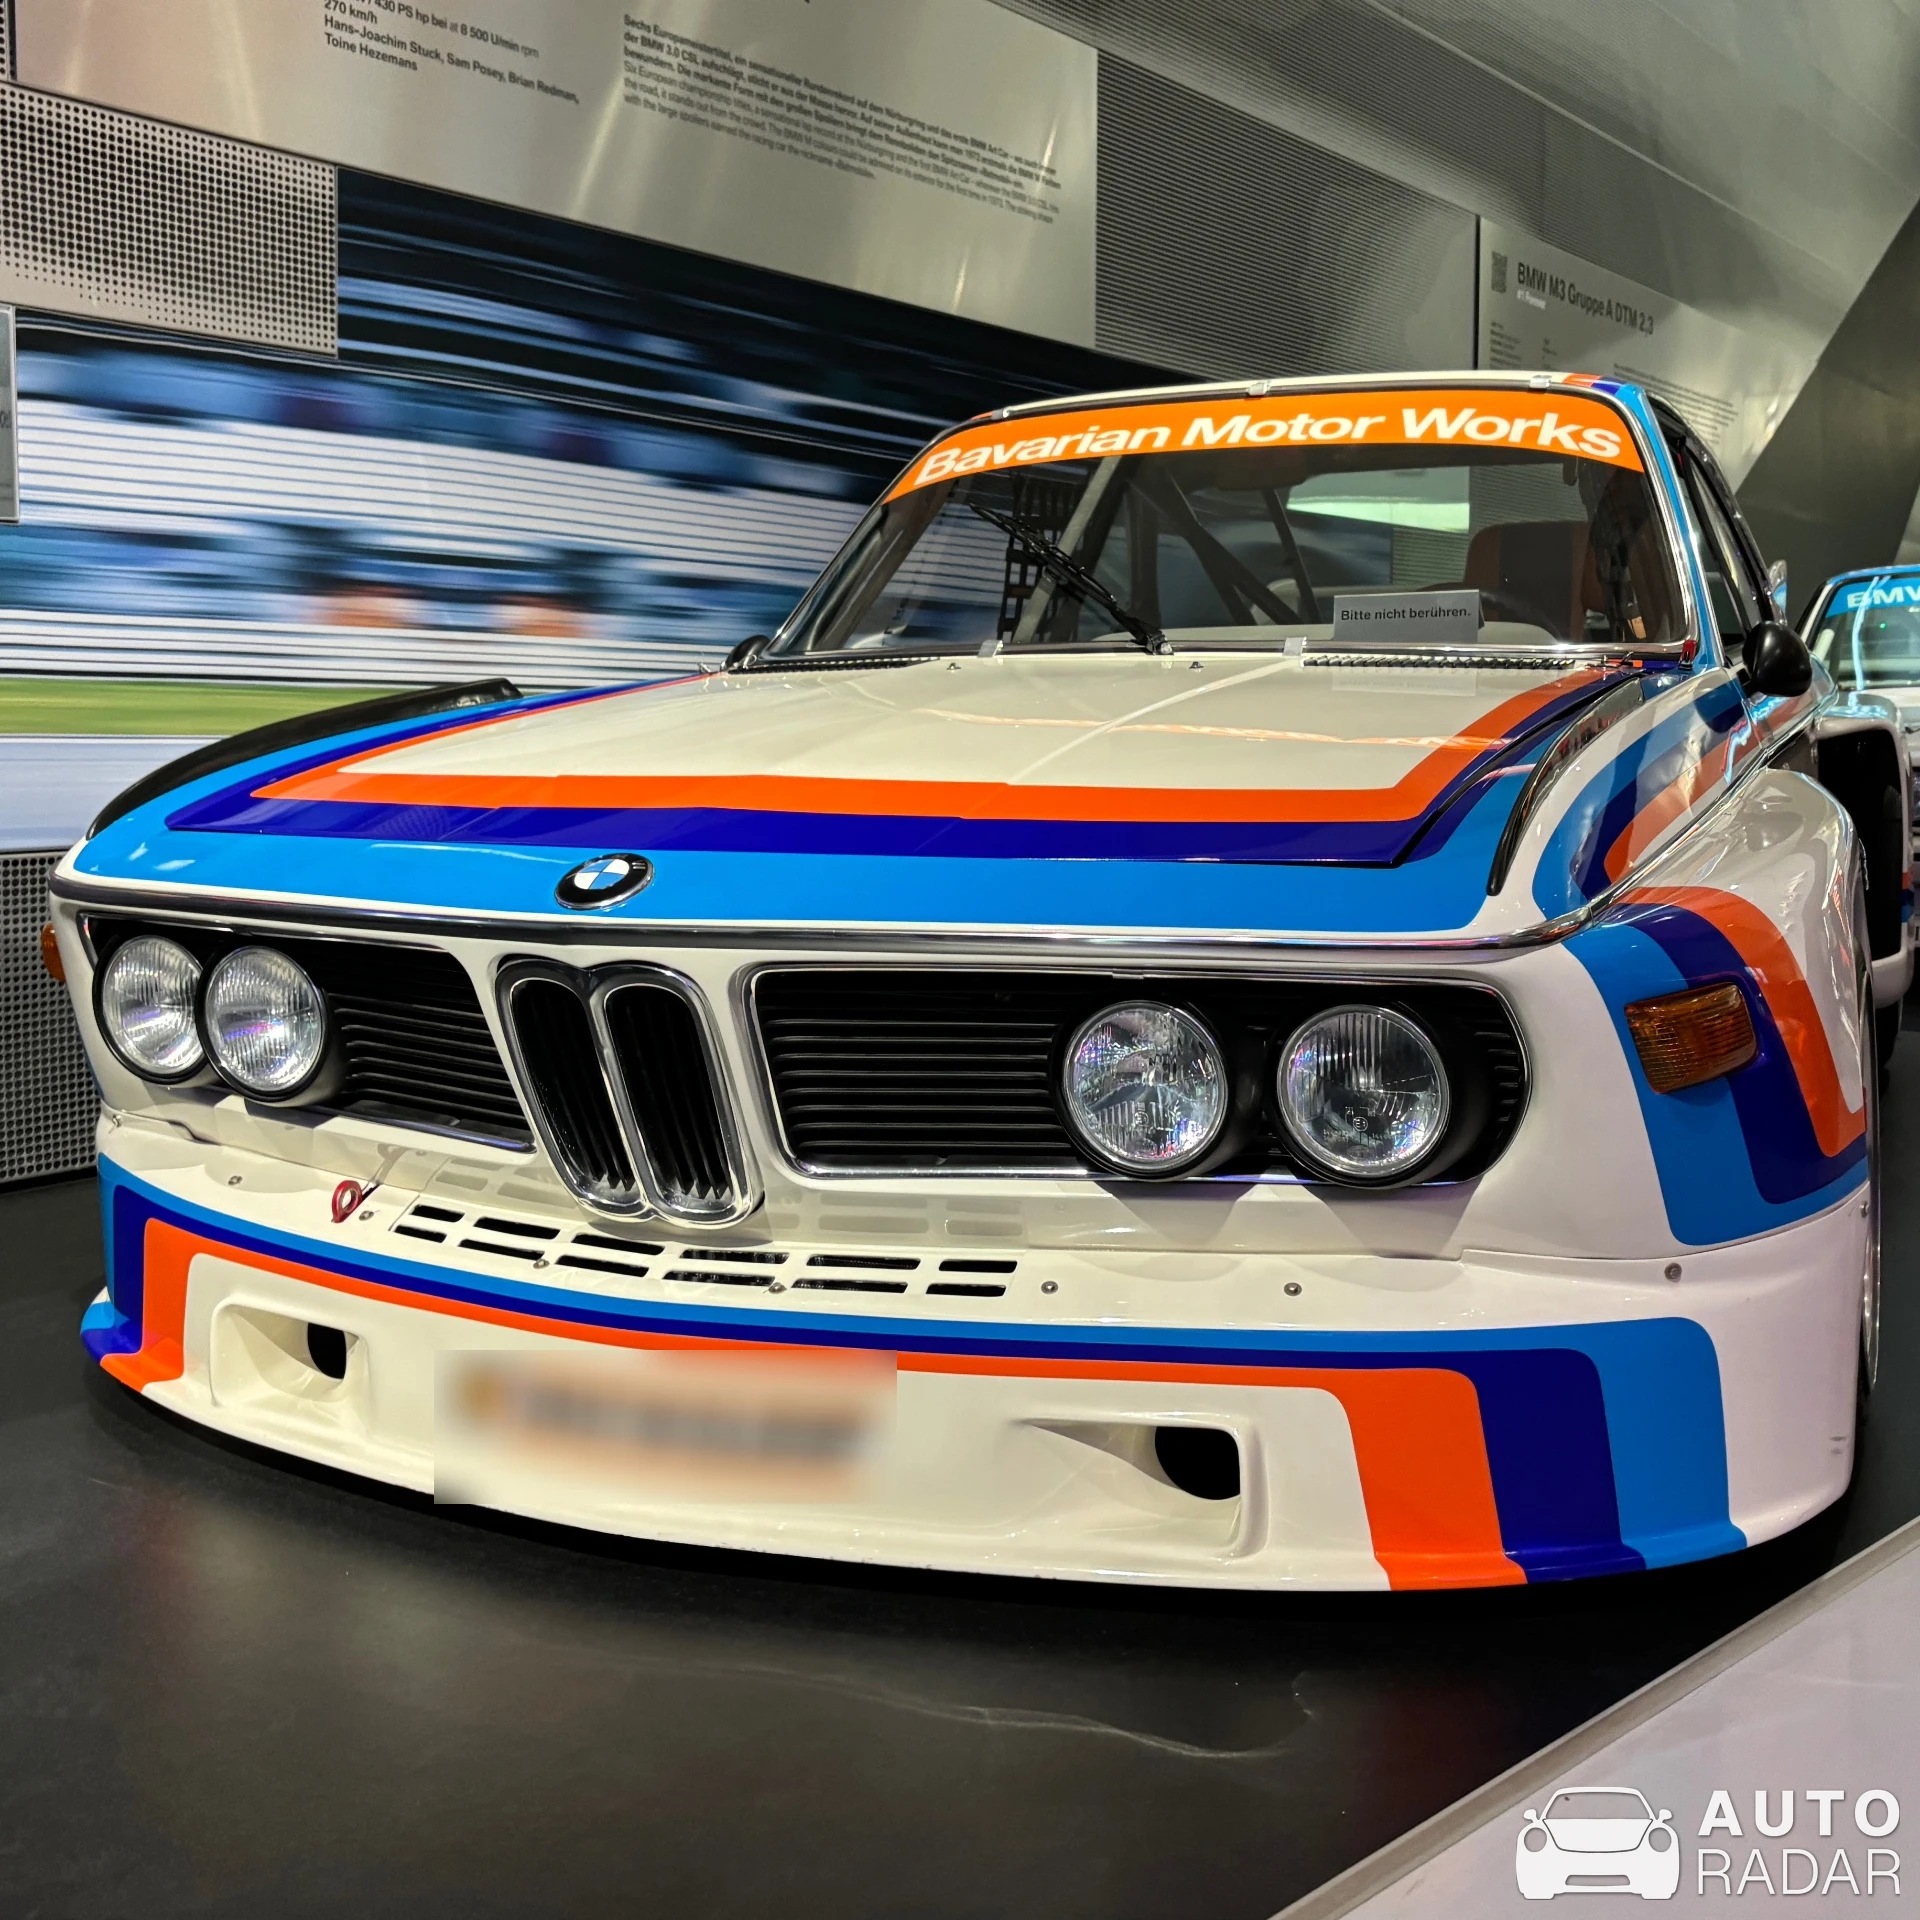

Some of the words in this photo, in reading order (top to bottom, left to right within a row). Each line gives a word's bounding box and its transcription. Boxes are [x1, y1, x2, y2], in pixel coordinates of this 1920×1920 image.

[324, 0, 346, 14] 270
[350, 4, 378, 24] km/h
[398, 3, 413, 18] PS
[416, 9, 429, 24] hp
[432, 14, 448, 29] bei
[460, 24, 468, 36] 8
[470, 26, 489, 42] 500
[324, 32, 356, 53] Toine
[360, 42, 418, 70] Hezemans
[324, 14, 407, 50] Hans-Joachim
[410, 41, 444, 64] Stuck,
[447, 52, 470, 70] Sam
[472, 60, 506, 82] Posey,
[508, 71, 535, 90] Brian
[537, 80, 579, 104] Redman,
[640, 35, 664, 53] BMW
[1518, 262, 1546, 292] BMW
[1550, 276, 1566, 300] M3
[1568, 283, 1604, 317] Gruppe
[1606, 298, 1613, 320] A
[1616, 302, 1637, 329] DTM
[914, 425, 1171, 485] Bavarian
[1182, 414, 1386, 446] Motor
[1402, 408, 1622, 458] Works
[1341, 609, 1371, 620] Bitte
[1374, 608, 1406, 620] nicht
[1410, 606, 1471, 618] berühren.
